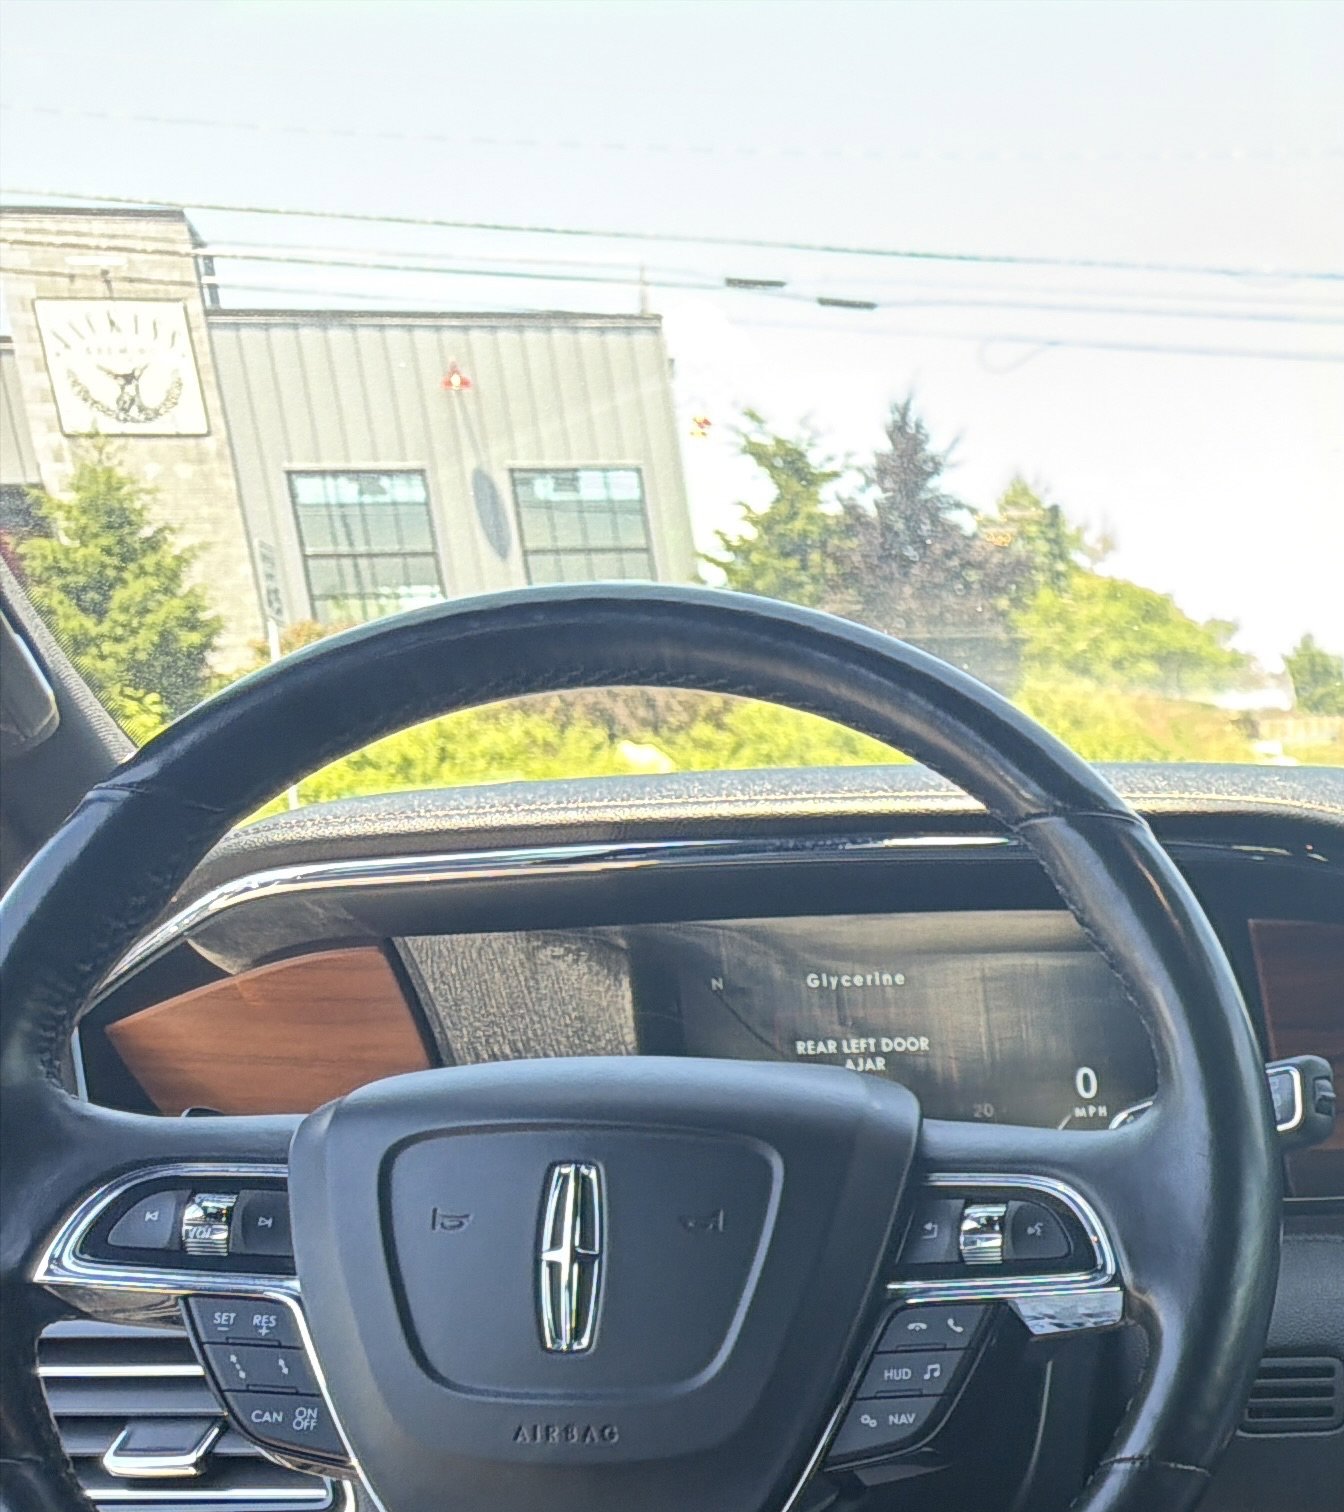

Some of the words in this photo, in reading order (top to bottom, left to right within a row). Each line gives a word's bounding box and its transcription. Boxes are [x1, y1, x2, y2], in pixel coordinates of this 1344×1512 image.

[806, 972, 906, 990] Glycerine
[796, 1040, 837, 1055] REAR
[842, 1037, 877, 1054] LEFT
[881, 1036, 930, 1053] DOOR
[845, 1056, 886, 1072] AJAR
[1075, 1066, 1098, 1099] 0
[973, 1103, 995, 1118] 20
[1074, 1105, 1108, 1118] MPH
[213, 1312, 237, 1325] SET
[252, 1314, 277, 1327] RES
[883, 1368, 912, 1380] HUD
[251, 1410, 284, 1423] CAN
[295, 1407, 318, 1419] ON
[888, 1413, 916, 1425] NAV
[293, 1419, 318, 1431] OFF
[511, 1422, 619, 1444] AIRBAG
